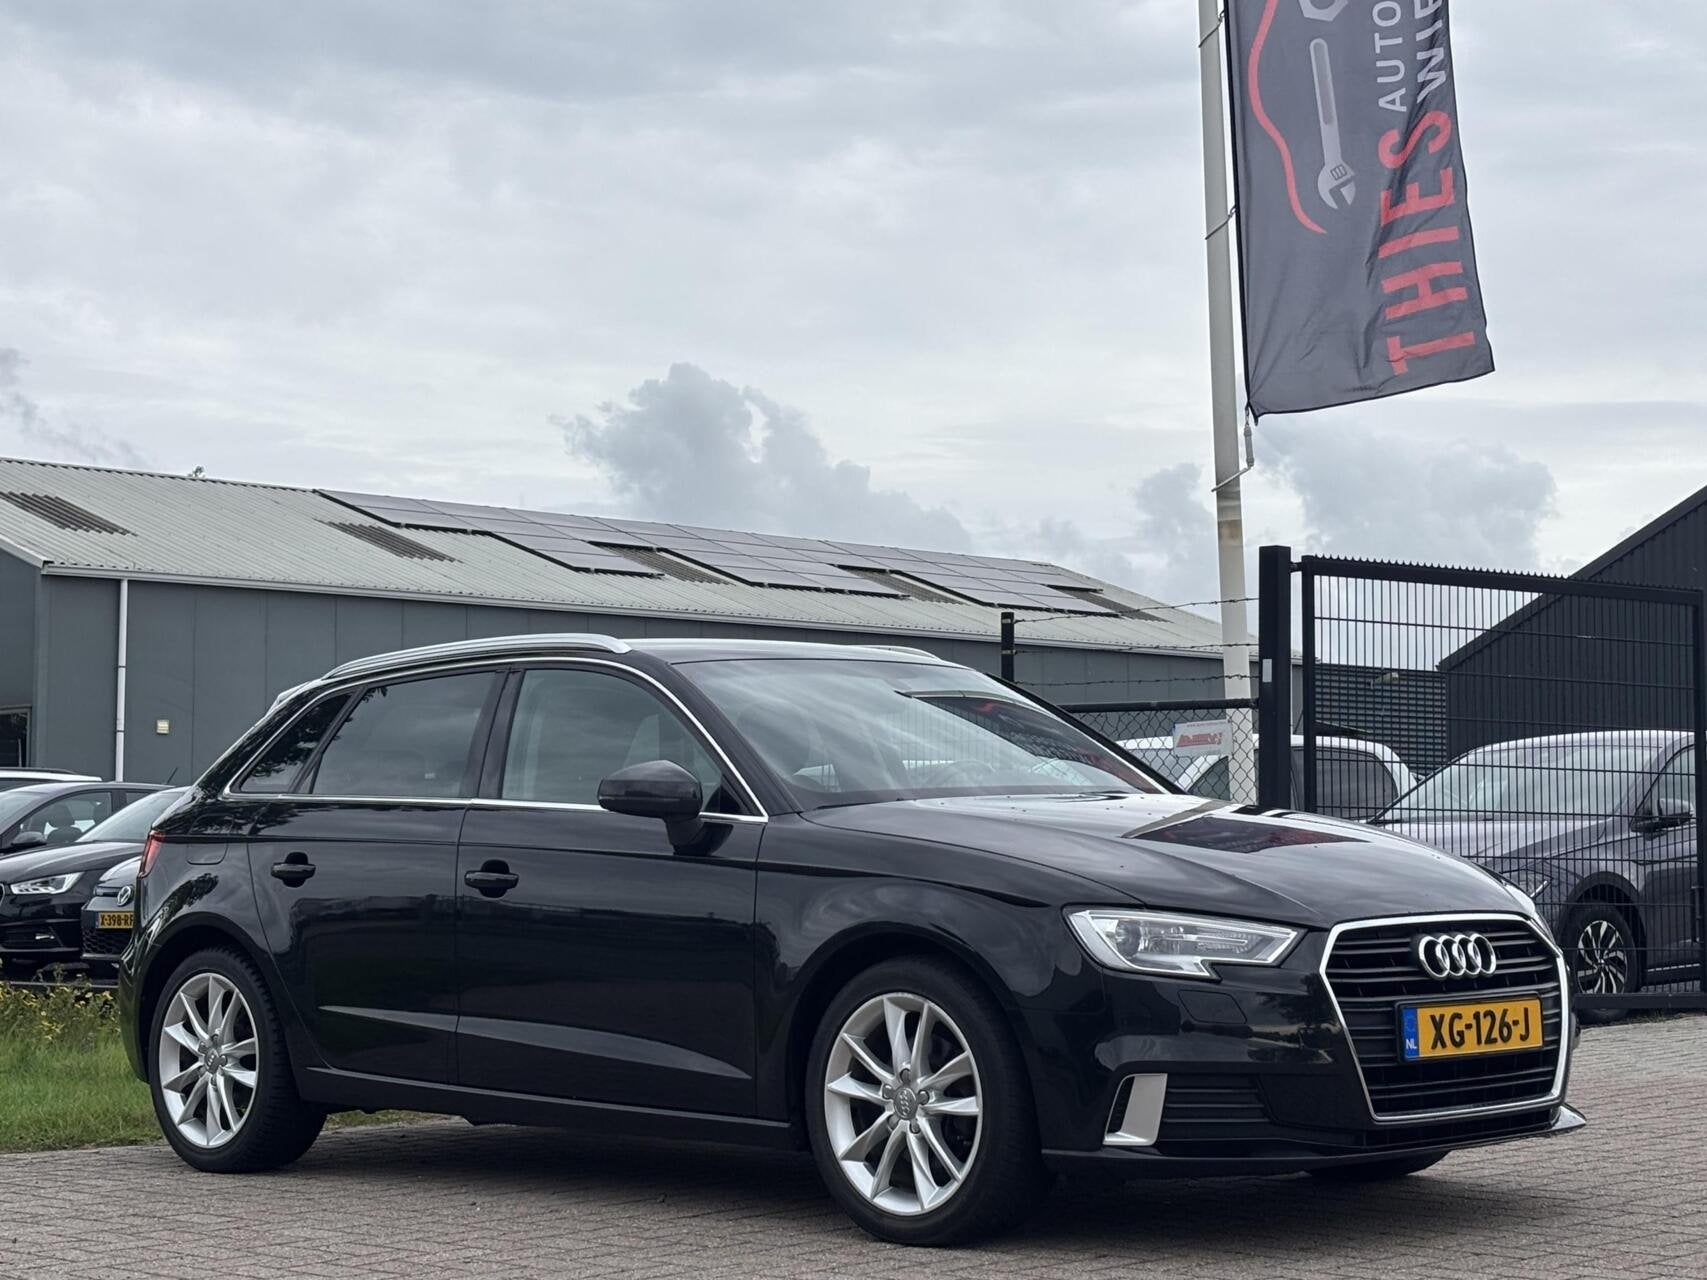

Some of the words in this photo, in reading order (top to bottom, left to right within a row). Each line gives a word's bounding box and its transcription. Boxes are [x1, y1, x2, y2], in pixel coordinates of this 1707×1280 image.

[1372, 1, 1407, 112] AUTO
[1378, 110, 1476, 376] THIES
[1405, 1038, 1417, 1050] NL
[1429, 1007, 1531, 1050] XG-126-J
